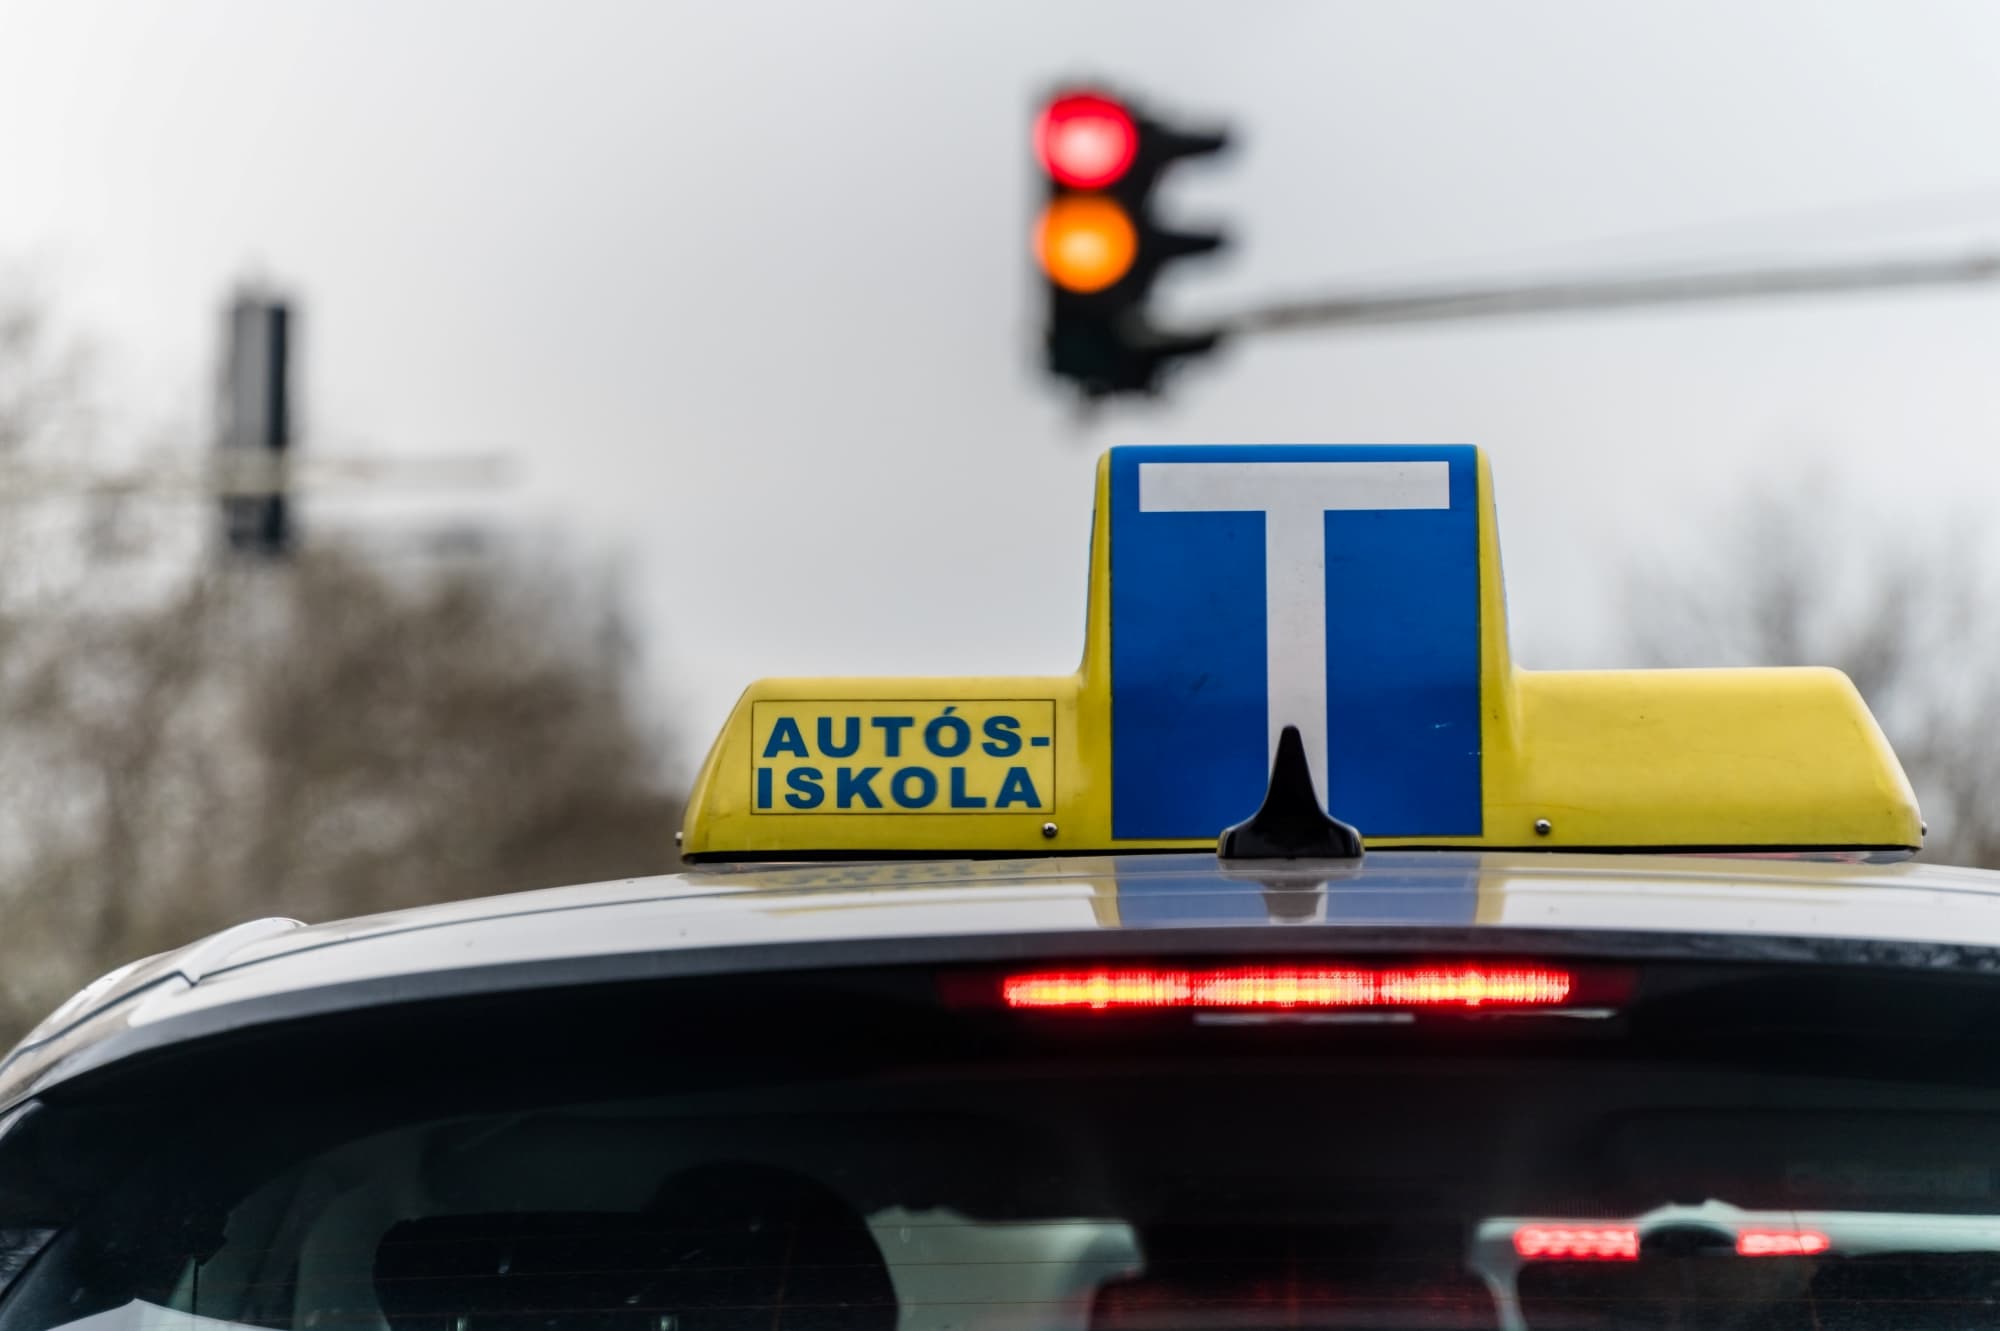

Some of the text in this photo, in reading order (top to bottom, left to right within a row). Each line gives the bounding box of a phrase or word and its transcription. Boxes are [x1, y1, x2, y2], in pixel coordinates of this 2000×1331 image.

[1139, 461, 1450, 814] T
[762, 706, 1051, 758] AUTÓS-
[757, 766, 1042, 809] ISKOLA
